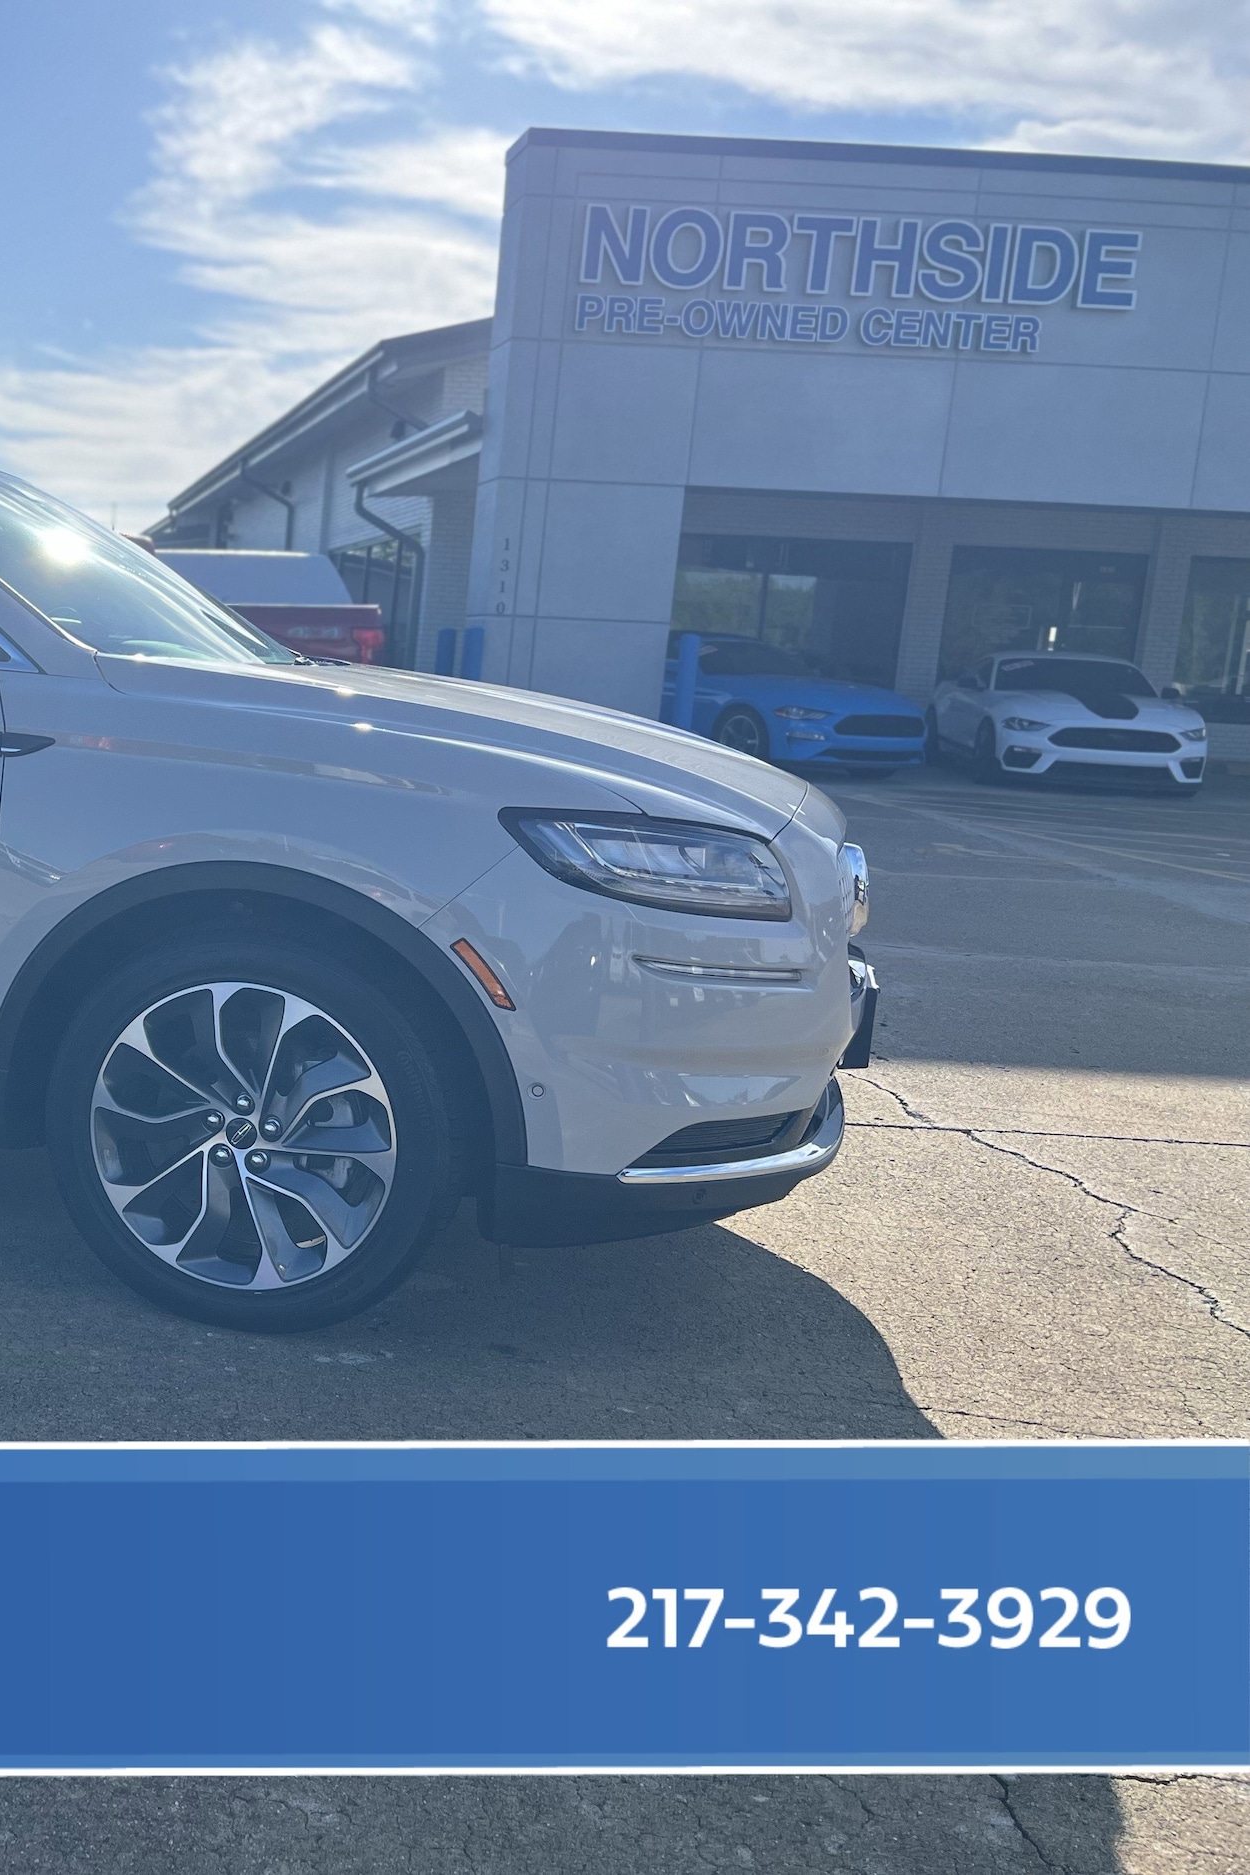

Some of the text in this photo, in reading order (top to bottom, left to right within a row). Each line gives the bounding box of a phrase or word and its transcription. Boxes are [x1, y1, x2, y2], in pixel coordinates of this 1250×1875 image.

[580, 203, 1141, 311] NORTHSIDE
[574, 294, 1041, 353] PRE-OWNED CENTER
[496, 537, 510, 615] 1310
